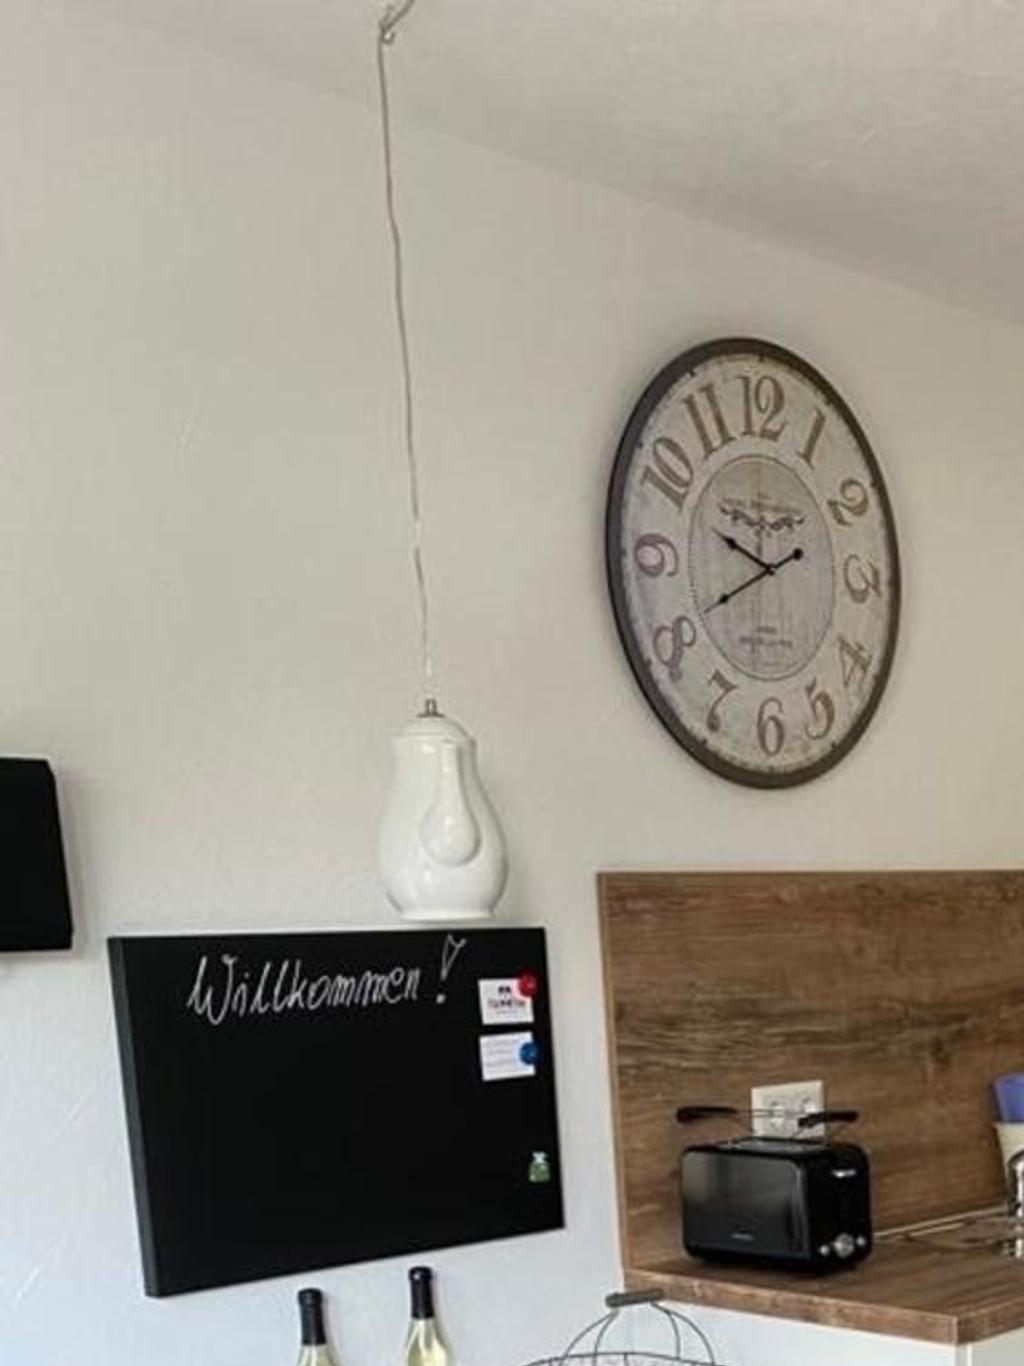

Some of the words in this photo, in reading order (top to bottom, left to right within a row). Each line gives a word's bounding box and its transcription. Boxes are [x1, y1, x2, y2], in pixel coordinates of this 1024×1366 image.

[683, 384, 735, 458] 11
[736, 374, 788, 443] 12
[797, 408, 827, 469] 1
[642, 436, 694, 509] 10
[828, 477, 871, 528] 2
[633, 533, 680, 579] 9
[843, 553, 882, 604] 3
[652, 614, 697, 684] 8
[835, 635, 873, 688] 4
[707, 669, 738, 733] 7
[756, 696, 786, 758] 6
[804, 679, 836, 740] 5
